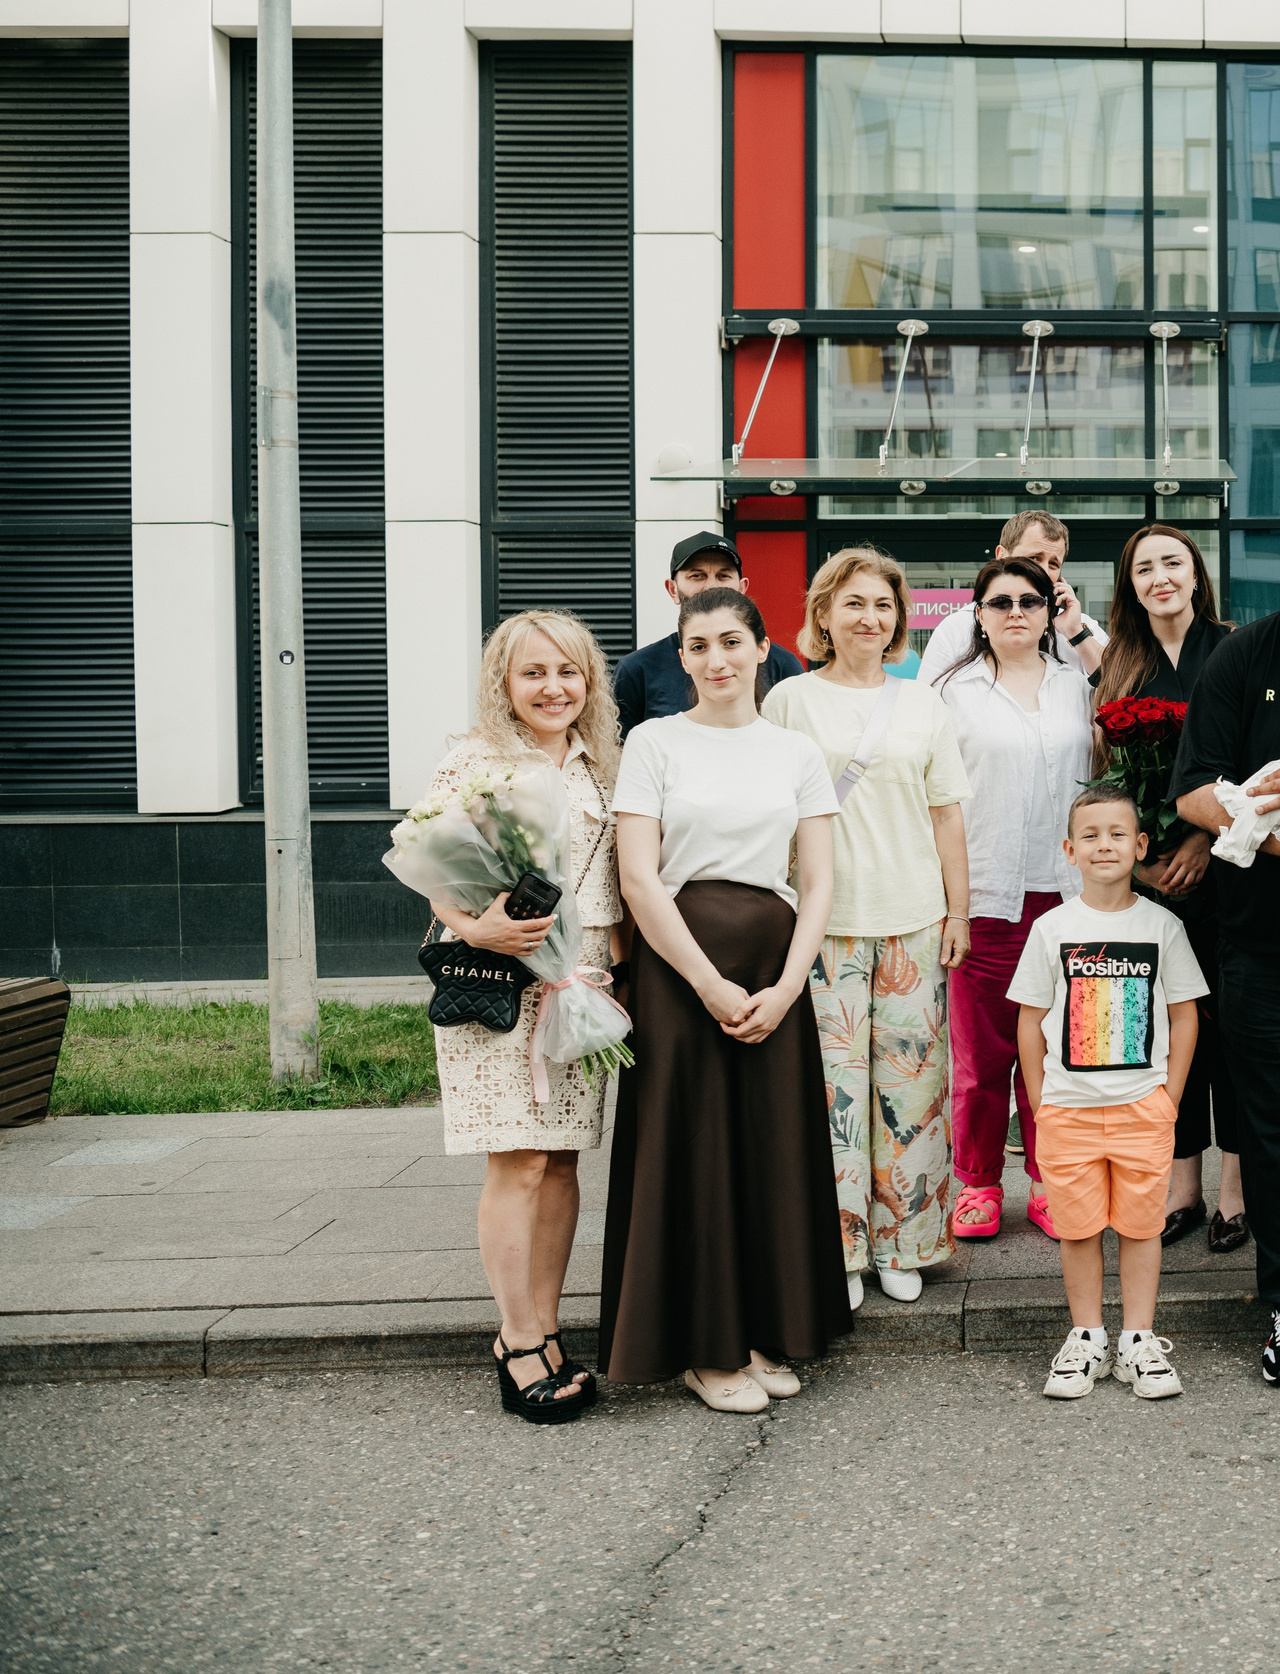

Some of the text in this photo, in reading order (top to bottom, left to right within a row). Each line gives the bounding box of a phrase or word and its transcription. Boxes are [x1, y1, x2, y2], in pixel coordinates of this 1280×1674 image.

[1064, 944, 1108, 967] Think
[441, 965, 514, 982] CHANEL
[1068, 958, 1152, 976] Positive
